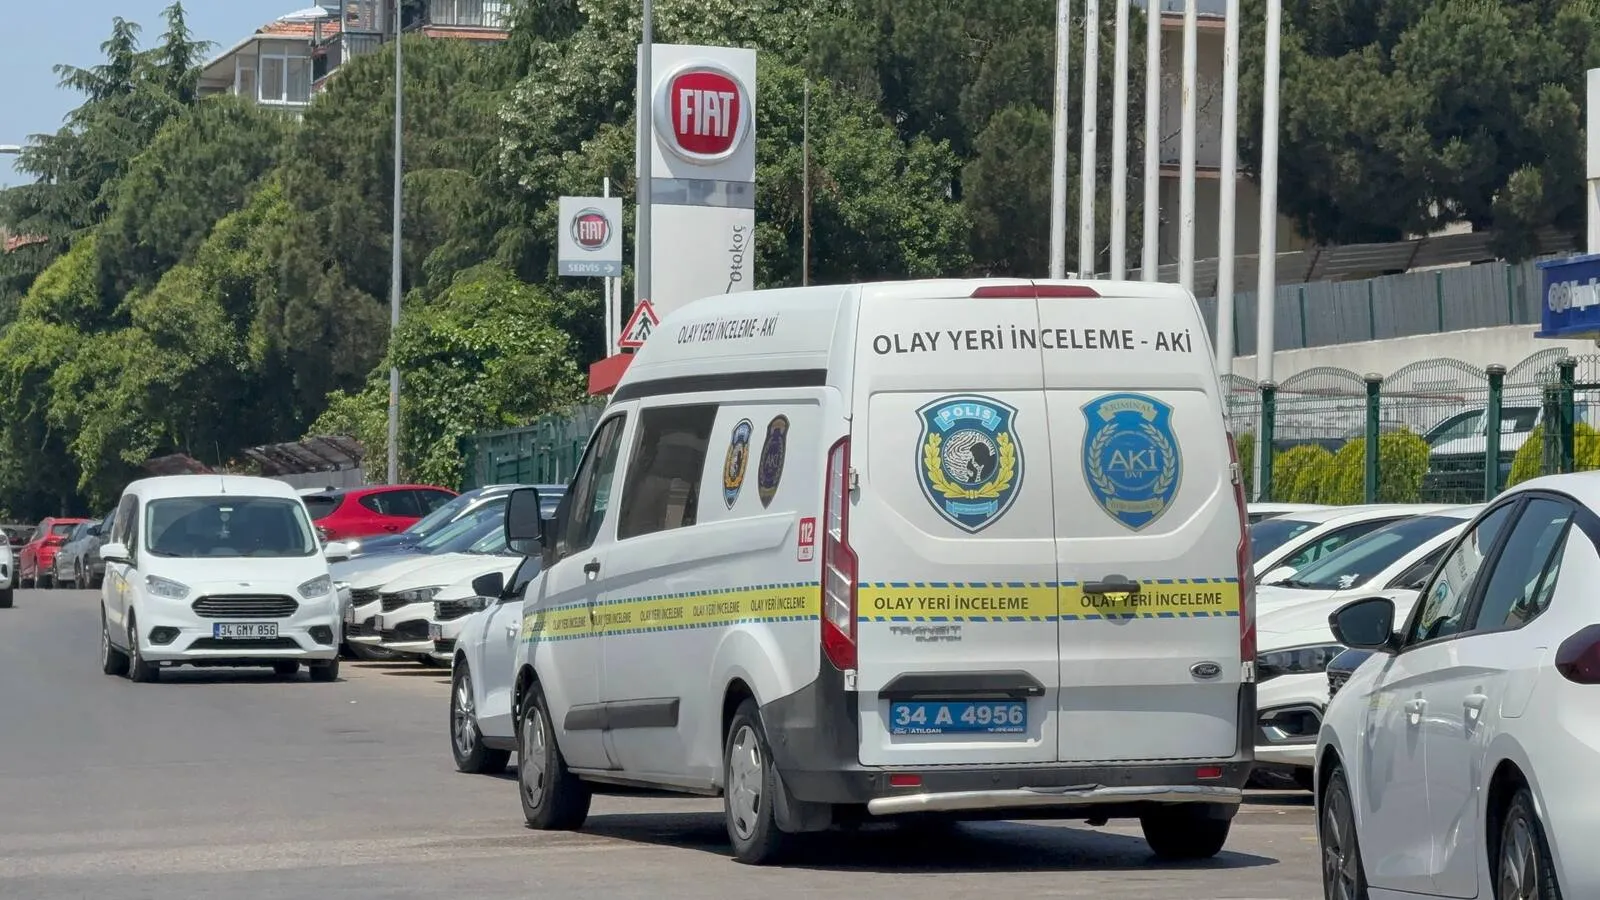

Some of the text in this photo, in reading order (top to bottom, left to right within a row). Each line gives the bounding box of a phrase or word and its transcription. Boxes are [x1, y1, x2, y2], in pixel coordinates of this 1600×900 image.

[680, 88, 735, 137] FIAT
[579, 220, 604, 240] FIAT
[728, 224, 747, 282] Otokoç
[678, 323, 700, 344] OLAY
[715, 317, 758, 340] İNCELEME
[760, 311, 780, 336] AKİ
[873, 331, 941, 354] OLAY
[946, 324, 1004, 350] YERİ
[1010, 324, 1135, 350] İNCELEME
[1155, 328, 1192, 352] AKİ
[941, 405, 992, 421] POLİS
[1108, 446, 1158, 471] AKİ
[801, 522, 813, 543] 112
[750, 599, 765, 612] OLAY
[776, 596, 806, 610] İNCELEME
[874, 594, 1029, 610] OLAY YERİ İNCELEME
[1080, 591, 1222, 608] OLAY YERİ İNCELEME
[692, 604, 706, 617] OLAY
[220, 625, 276, 636] 34 GMY 856
[895, 705, 1024, 725] 34 A 4956
